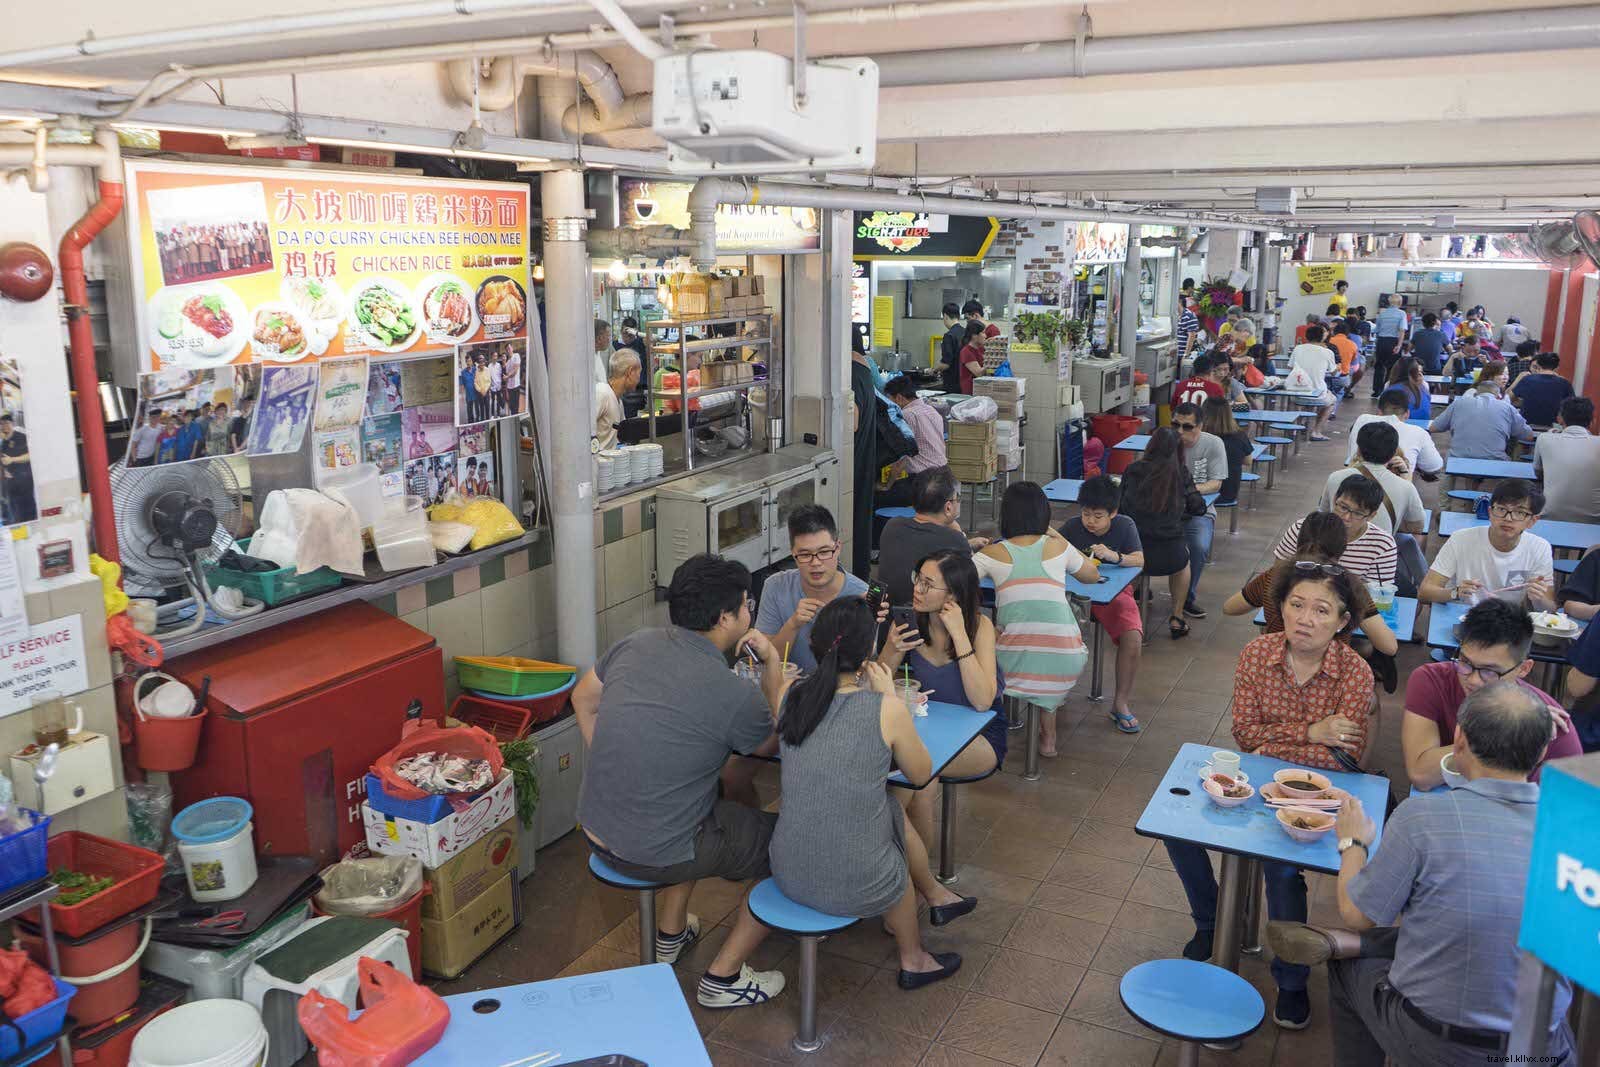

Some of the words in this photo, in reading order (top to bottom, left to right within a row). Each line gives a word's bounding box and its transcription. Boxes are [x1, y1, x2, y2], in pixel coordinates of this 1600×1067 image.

[277, 231, 300, 245] DA
[304, 231, 325, 246] PO
[329, 231, 375, 246] CURRY
[380, 231, 436, 245] CHICKEN
[439, 231, 460, 245] BEE
[463, 232, 497, 245] HOON
[500, 232, 521, 245] MEE
[857, 226, 929, 238] SIGNATURE
[352, 256, 418, 272] CHICKEN
[422, 255, 452, 271] RICE
[19, 629, 71, 653] SERVICE
[35, 666, 53, 677] FOR
[54, 659, 77, 672] YOUR
